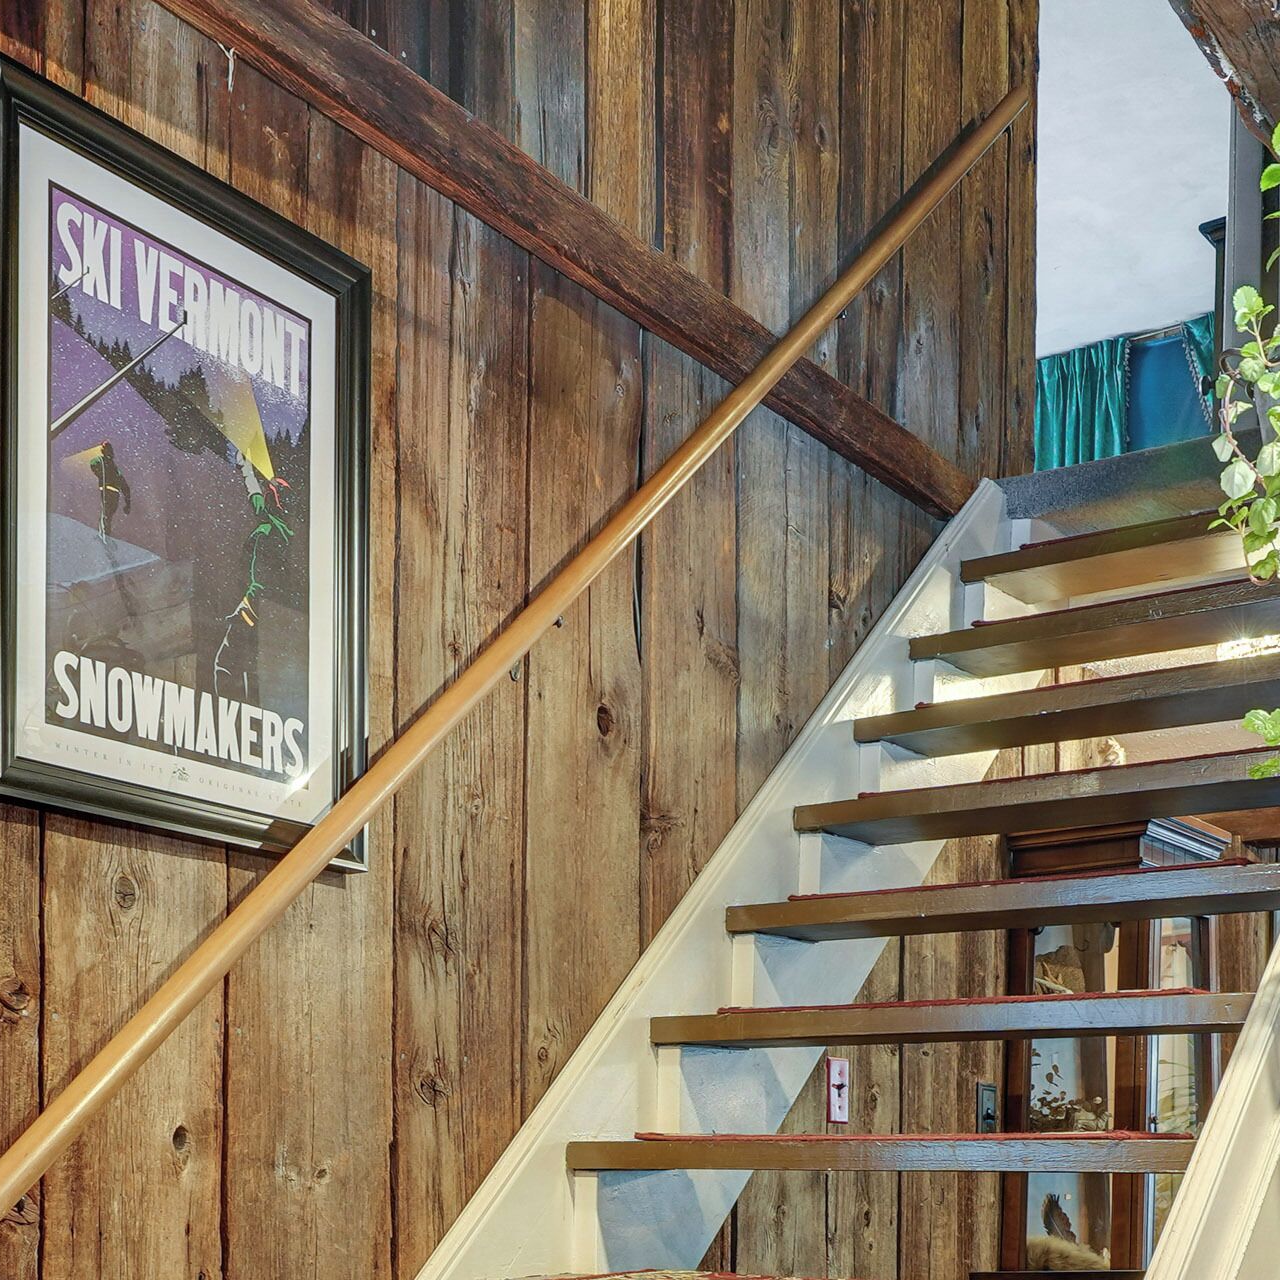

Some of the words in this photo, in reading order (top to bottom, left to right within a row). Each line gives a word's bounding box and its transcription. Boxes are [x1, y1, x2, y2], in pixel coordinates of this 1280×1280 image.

[56, 202, 122, 310] SKI
[134, 239, 306, 397] VERMONT
[53, 651, 305, 777] SNOWMAKERS
[55, 742, 107, 760] WINTER
[199, 776, 259, 797] ORIGINAL
